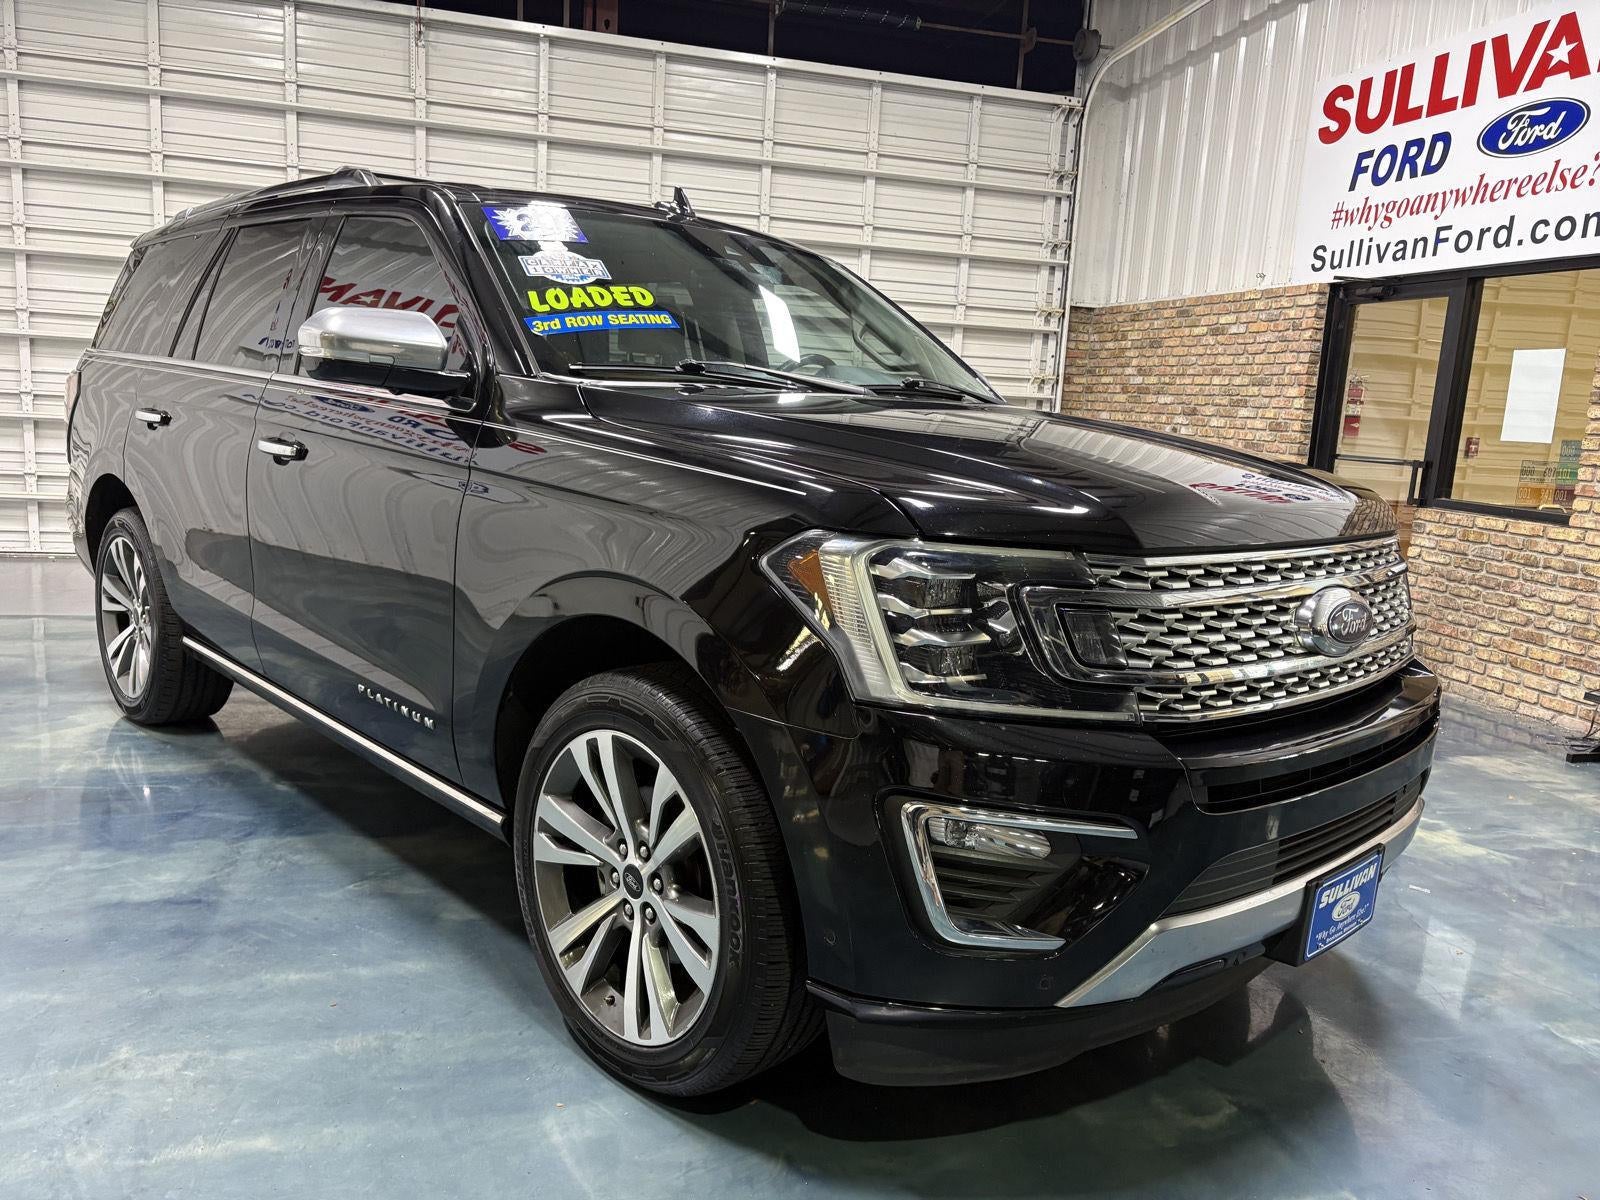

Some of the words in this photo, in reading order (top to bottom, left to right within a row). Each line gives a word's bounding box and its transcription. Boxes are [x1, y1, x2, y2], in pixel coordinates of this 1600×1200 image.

[1318, 11, 1600, 145] SULLIVA
[1498, 106, 1567, 150] Ford
[1348, 131, 1452, 192] FORD
[527, 285, 655, 313] LOADED
[531, 318, 562, 332] 3rd
[564, 314, 603, 328] ROW
[607, 314, 673, 326] SEATING
[1341, 608, 1367, 636] Ford
[357, 683, 435, 731] PLATINUM
[1318, 862, 1378, 909] SULLIVAN
